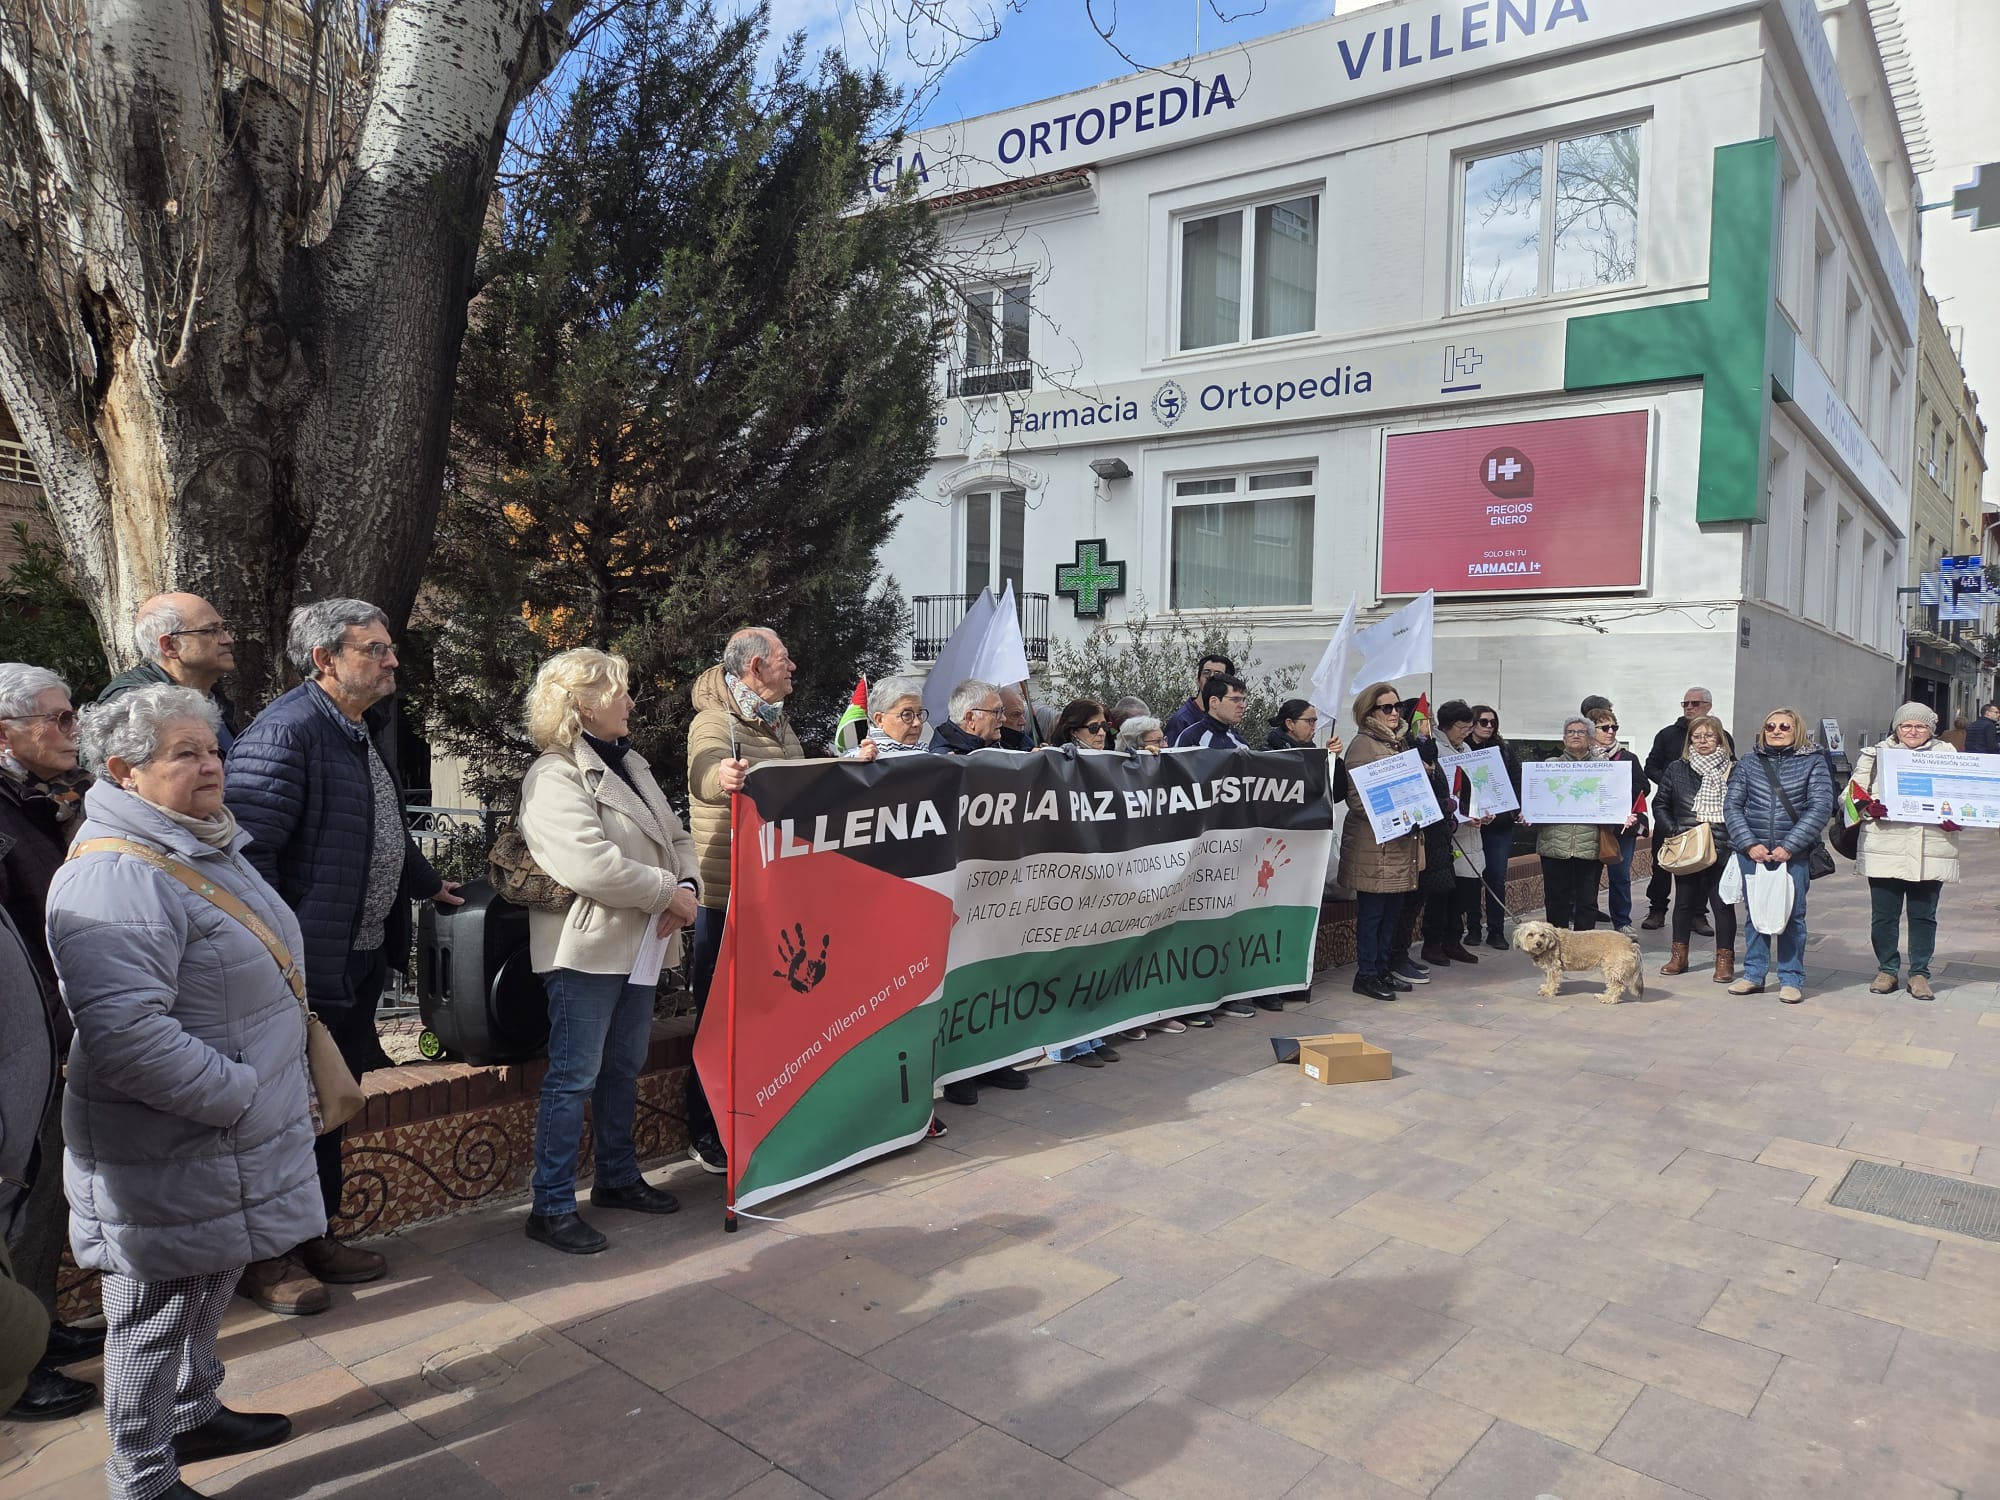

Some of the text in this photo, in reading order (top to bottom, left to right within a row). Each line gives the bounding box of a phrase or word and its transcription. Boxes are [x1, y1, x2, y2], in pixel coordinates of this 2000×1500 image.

[998, 73, 1235, 165] ORTOPEDIA
[1337, 0, 1589, 81] VILLENA
[1010, 396, 1138, 434] Farmacia
[1200, 365, 1372, 412] Ortopedia
[1486, 503, 1533, 515] PRECIOS
[1490, 514, 1527, 526] ENERO
[1468, 562, 1526, 574] FARMACIA
[758, 776, 1305, 869] VILLENA POR LA PAZ EN PALESTINA
[966, 870, 1008, 891] ¡STOP
[1010, 867, 1023, 885] AL
[1026, 863, 1115, 881] TERRORISMO
[1117, 862, 1124, 876] Y
[1125, 861, 1133, 876] A
[1133, 856, 1162, 873] TODAS
[1163, 853, 1186, 869] LAS
[966, 903, 1006, 925] ¡ALTO
[1008, 901, 1022, 917] EL
[1025, 895, 1074, 914] FUEGO
[1078, 894, 1097, 911] YA!
[1098, 891, 1136, 909] ¡STOP
[1193, 867, 1240, 883] ISRAEL!
[1021, 927, 1063, 946] ¡CESE
[1065, 925, 1082, 941] DE
[1083, 923, 1097, 937] LA
[1068, 940, 1232, 1009] HUMANOS
[1238, 929, 1282, 969] YA!
[755, 956, 931, 1107] Plataforma Villena por la Paz
